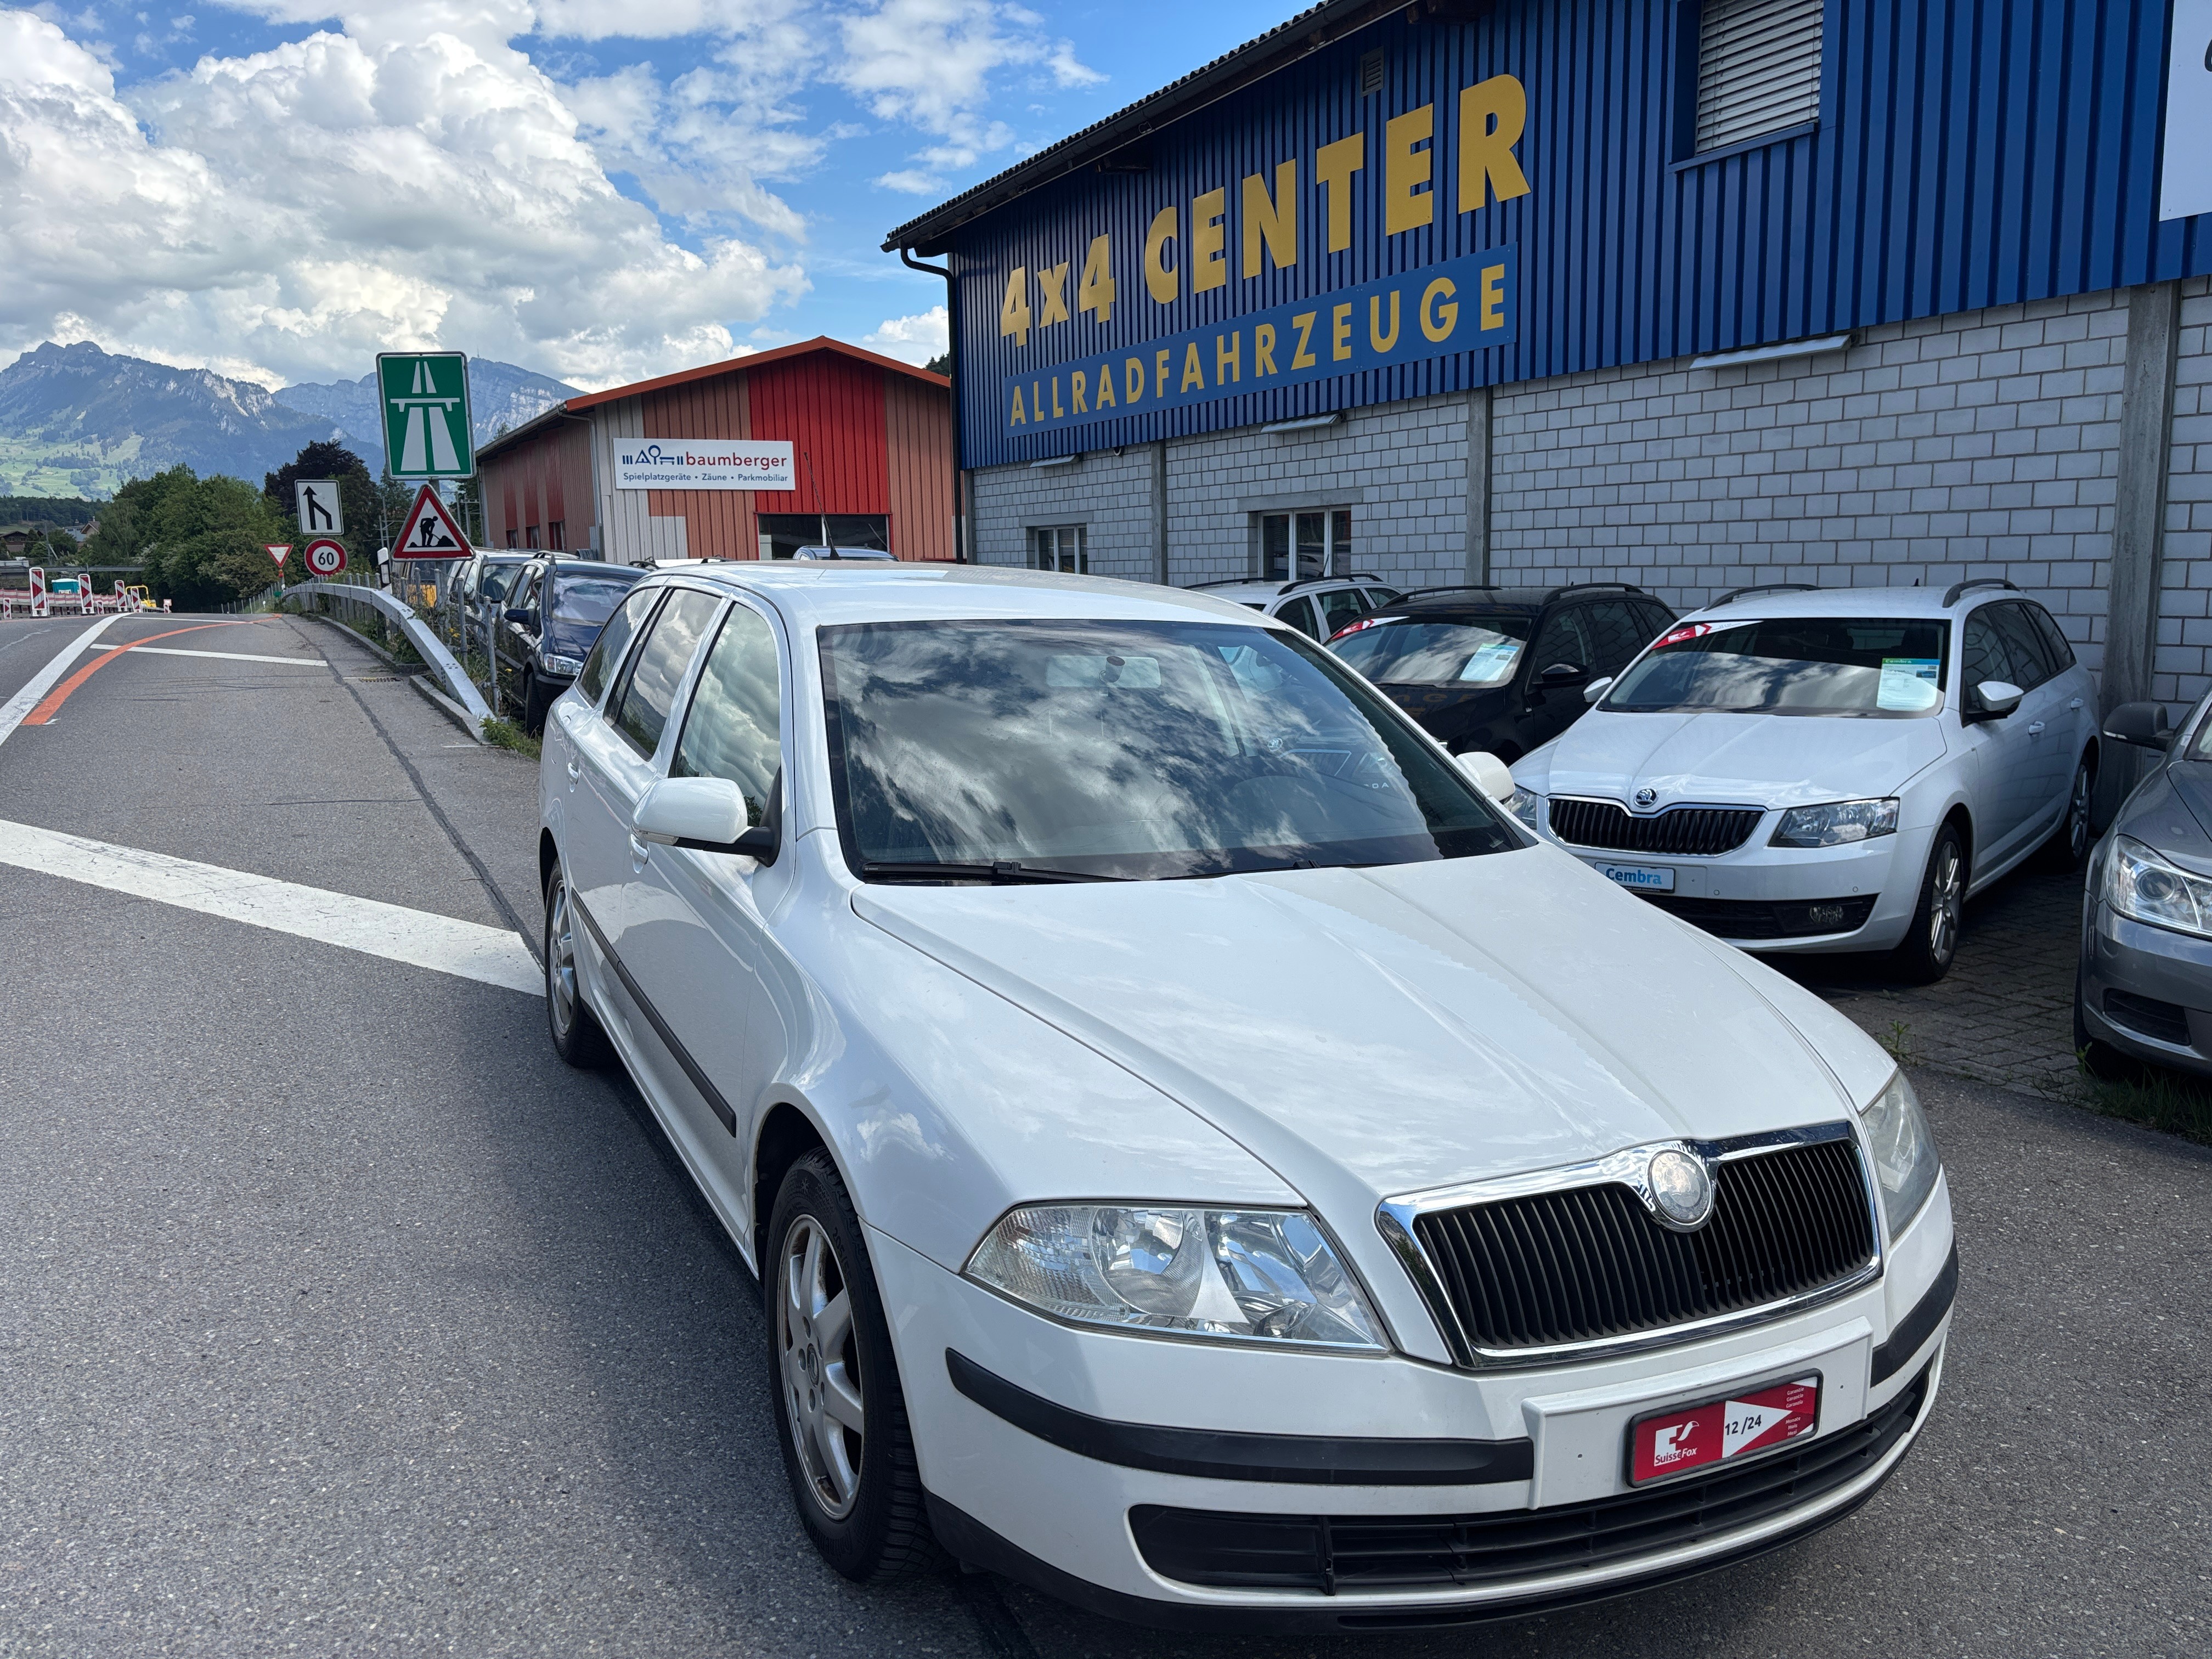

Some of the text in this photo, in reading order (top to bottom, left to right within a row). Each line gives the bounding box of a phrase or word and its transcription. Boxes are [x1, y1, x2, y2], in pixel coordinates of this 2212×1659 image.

[1144, 74, 1531, 304] CENTER
[1009, 263, 1505, 427] ALLRADFAHRZEUGE
[686, 452, 787, 470] baumberger
[623, 472, 788, 482] Spielplatzgeräte Zäune Parkmobiliar
[318, 552, 334, 565] 60
[1606, 868, 1662, 884] Cembra
[1787, 1387, 1804, 1395] Garantie
